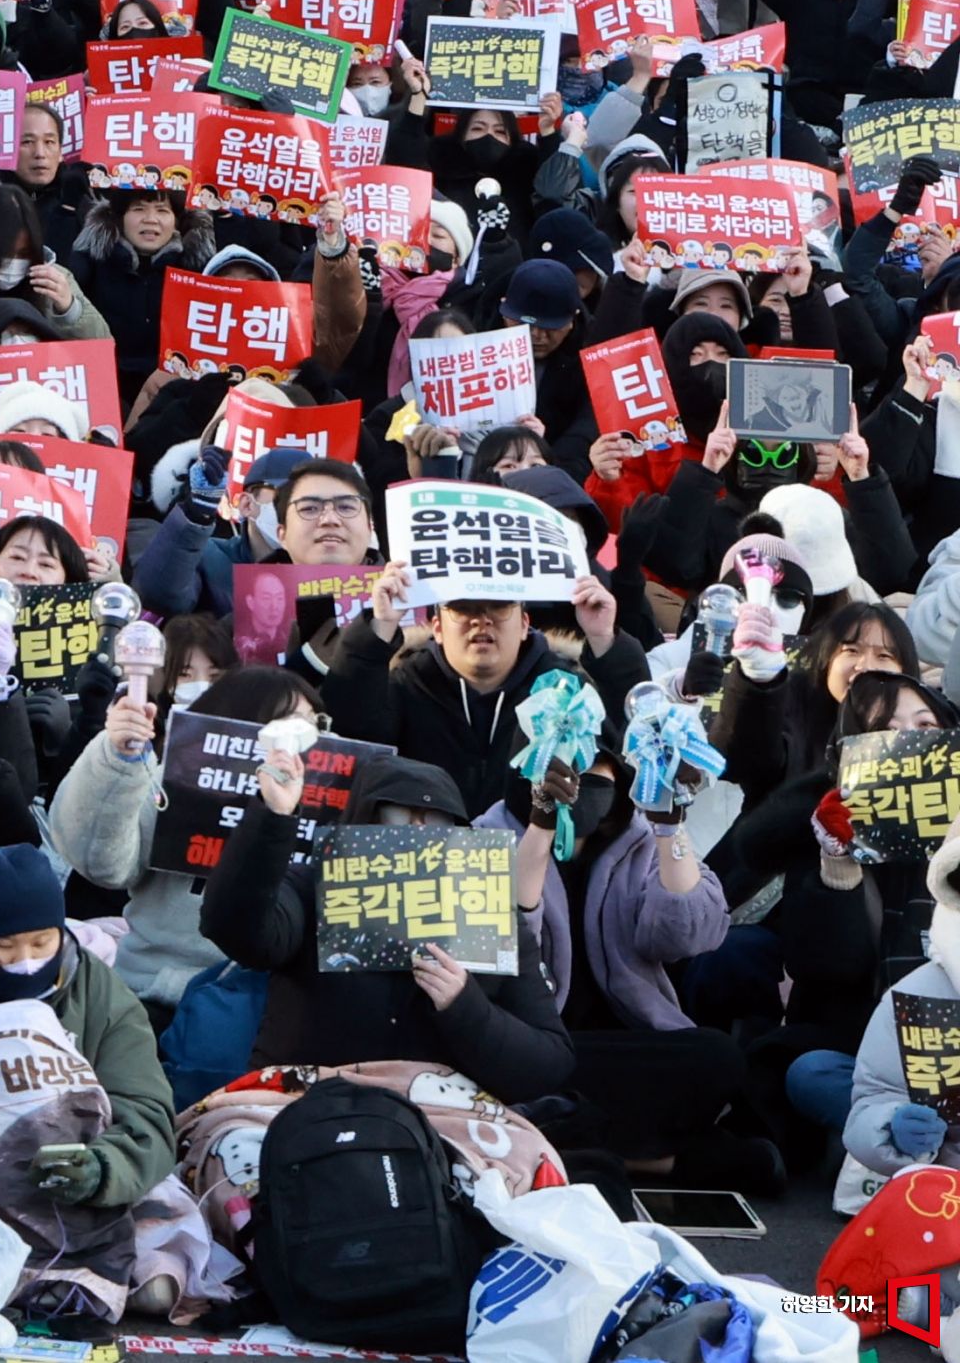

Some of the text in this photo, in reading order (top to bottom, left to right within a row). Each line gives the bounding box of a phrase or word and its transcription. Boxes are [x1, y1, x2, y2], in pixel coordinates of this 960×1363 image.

[232, 32, 339, 67] 내란수괴 윤석열
[431, 37, 541, 55] 내란수괴 윤석열
[104, 111, 196, 161] 탄핵
[218, 128, 324, 169] 윤석열을
[700, 129, 764, 157] 탄핵을
[215, 158, 323, 201] 탄핵하라
[643, 190, 790, 218] 내란수괴 윤석열
[645, 210, 794, 240] 법대로 처단하라
[186, 299, 290, 362] 탄핵
[419, 334, 530, 378] 내란범 윤석열
[420, 364, 533, 418] 체포하라
[610, 356, 669, 419] 탄
[410, 508, 569, 550] 윤석열을
[410, 546, 578, 581] 탄핵하라
[842, 750, 923, 789] 내란수괴
[323, 847, 511, 883] 내란수괴 윤석열
